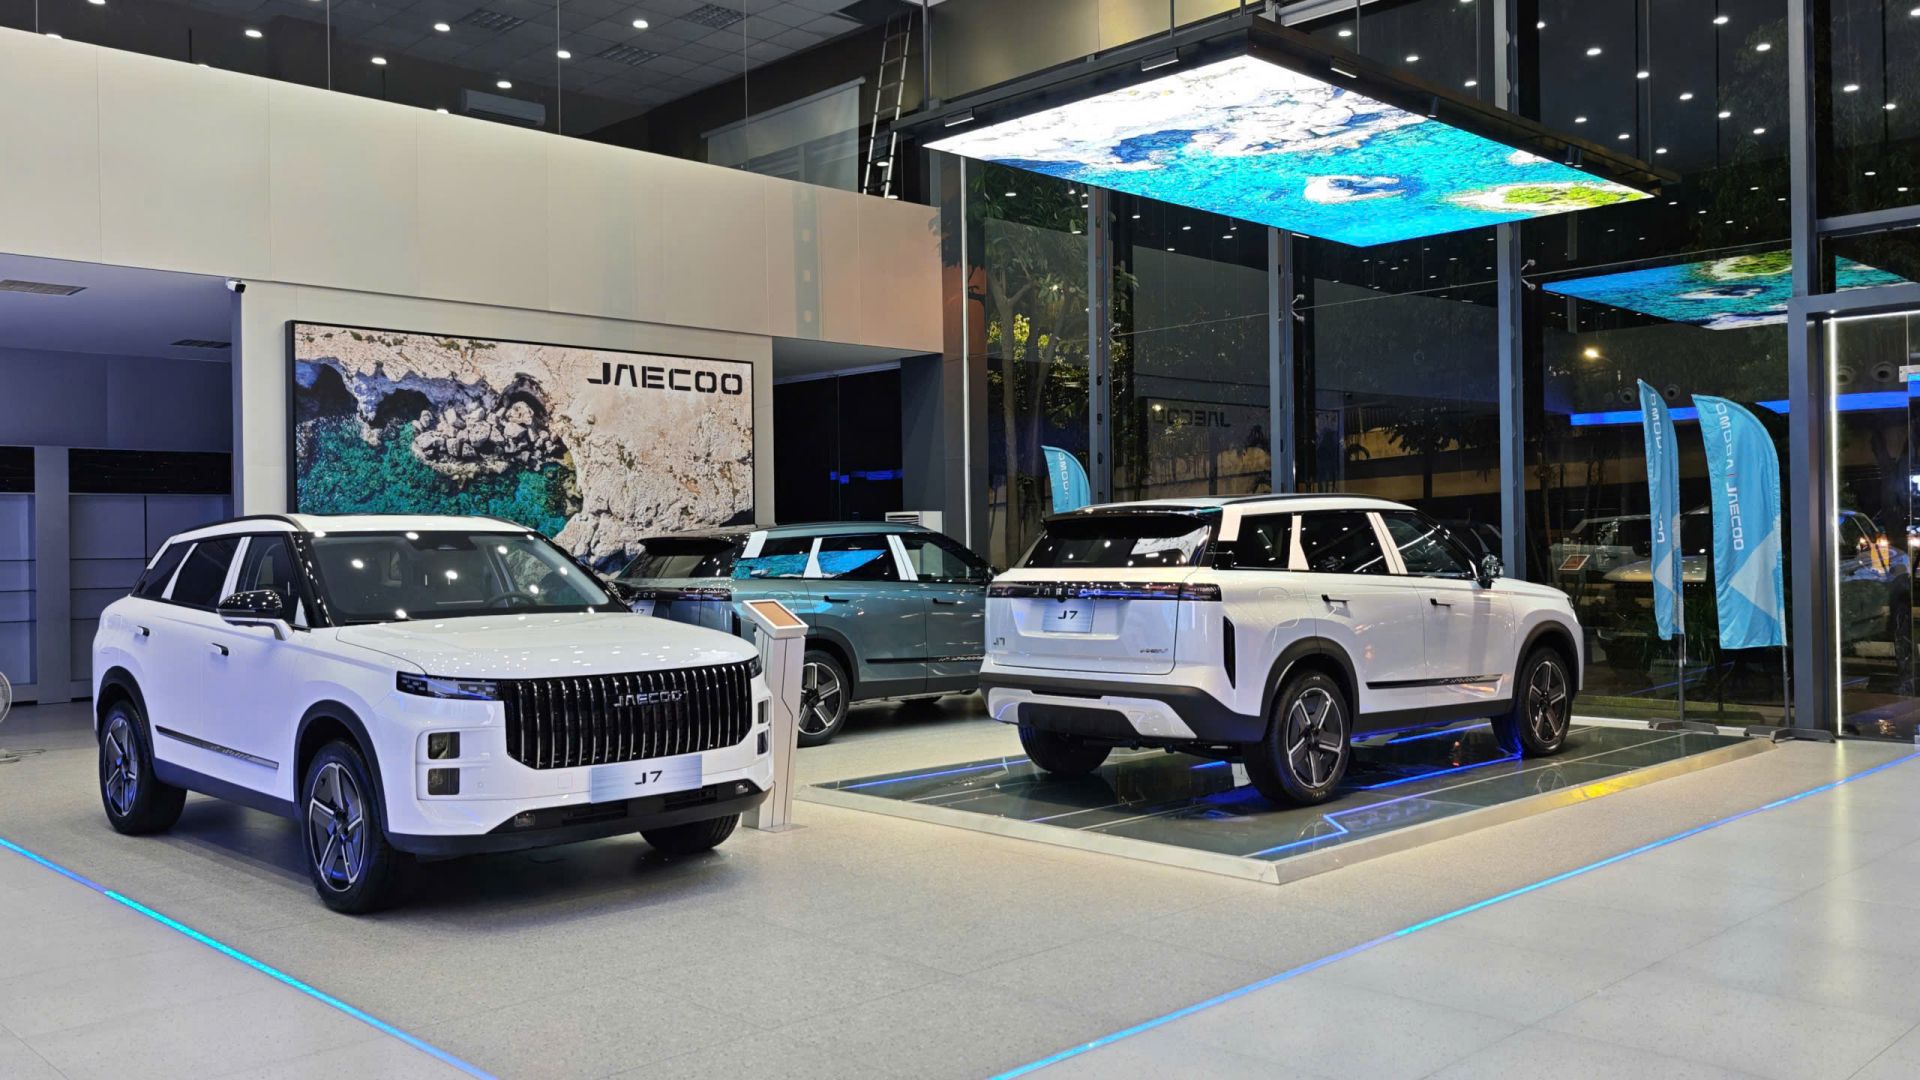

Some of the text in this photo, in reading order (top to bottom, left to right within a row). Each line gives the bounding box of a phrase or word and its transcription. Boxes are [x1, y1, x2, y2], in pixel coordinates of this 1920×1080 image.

[587, 362, 743, 396] JAECOO
[1715, 402, 1745, 551] OMODA JAECOO
[1057, 610, 1078, 620] J7
[613, 690, 683, 707] JAECOO
[634, 770, 663, 785] J7
